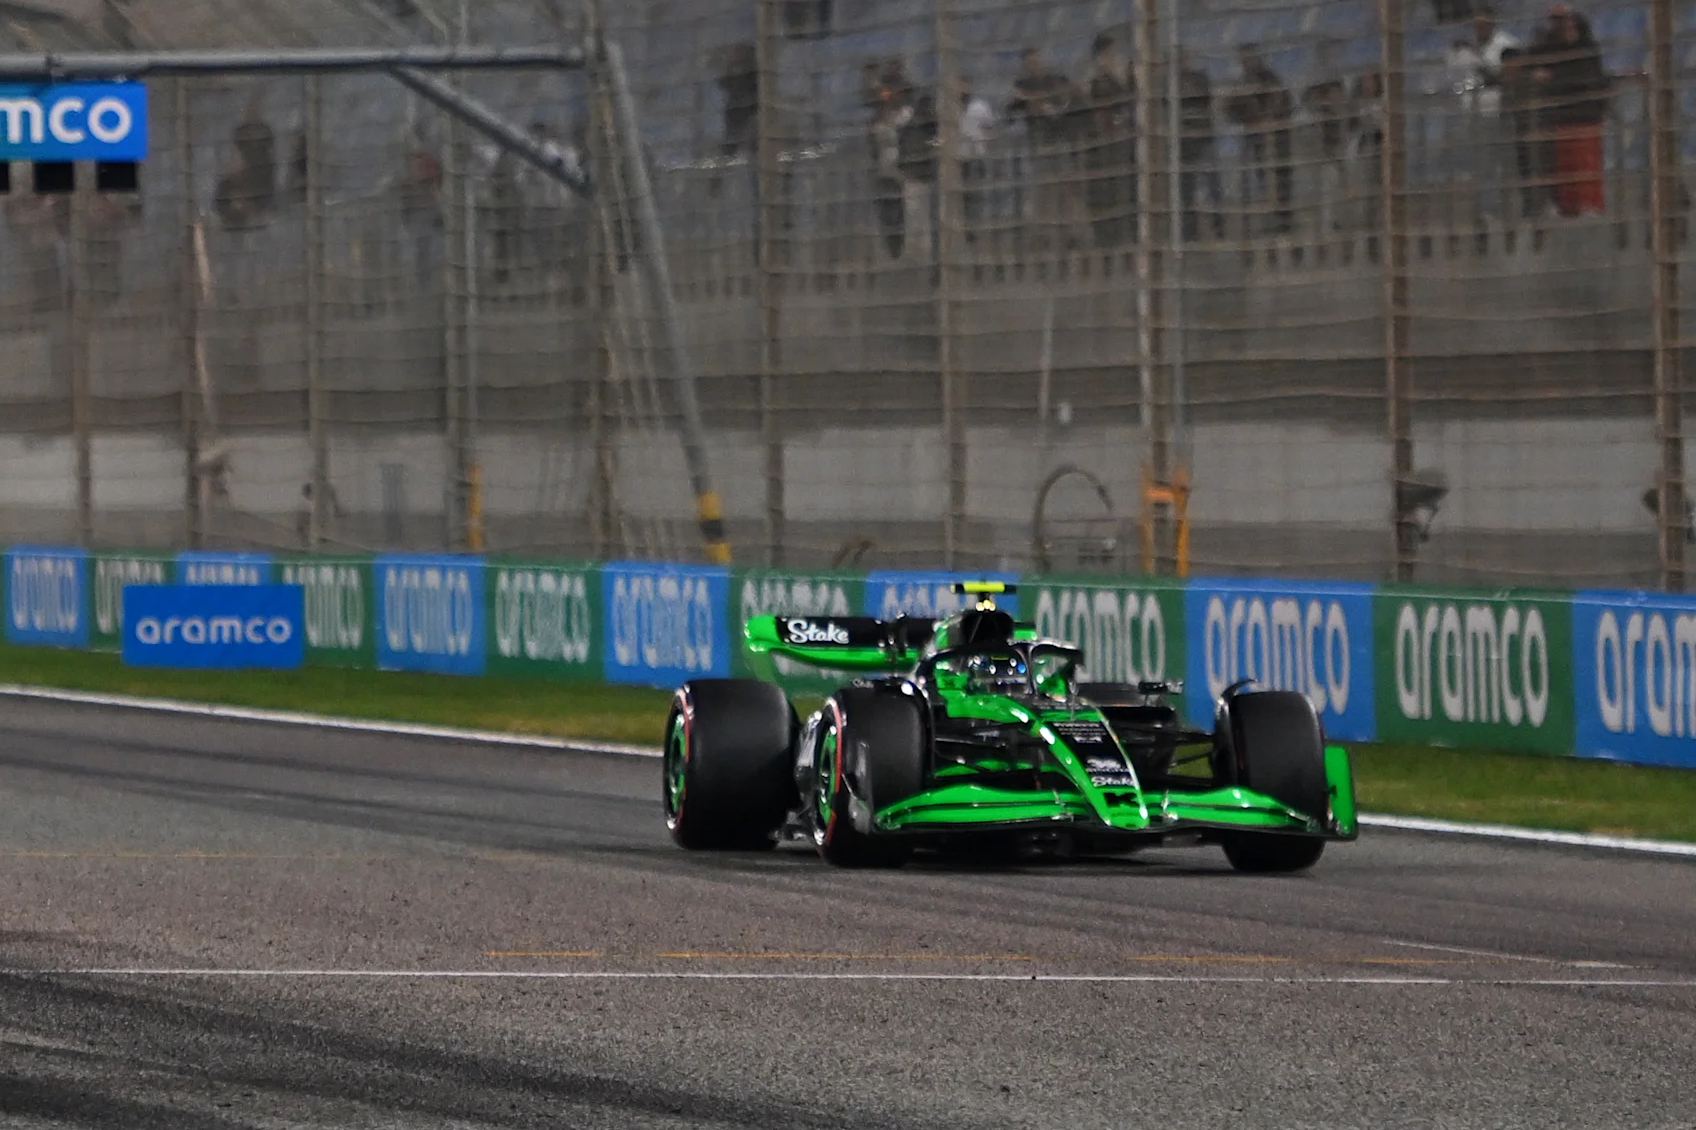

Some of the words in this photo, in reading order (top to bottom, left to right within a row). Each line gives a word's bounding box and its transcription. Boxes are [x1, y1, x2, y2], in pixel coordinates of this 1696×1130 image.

[136, 616, 292, 646] aramco
[787, 619, 849, 645] Stake
[1206, 595, 1350, 715] aramco
[1396, 604, 1549, 728] aramco
